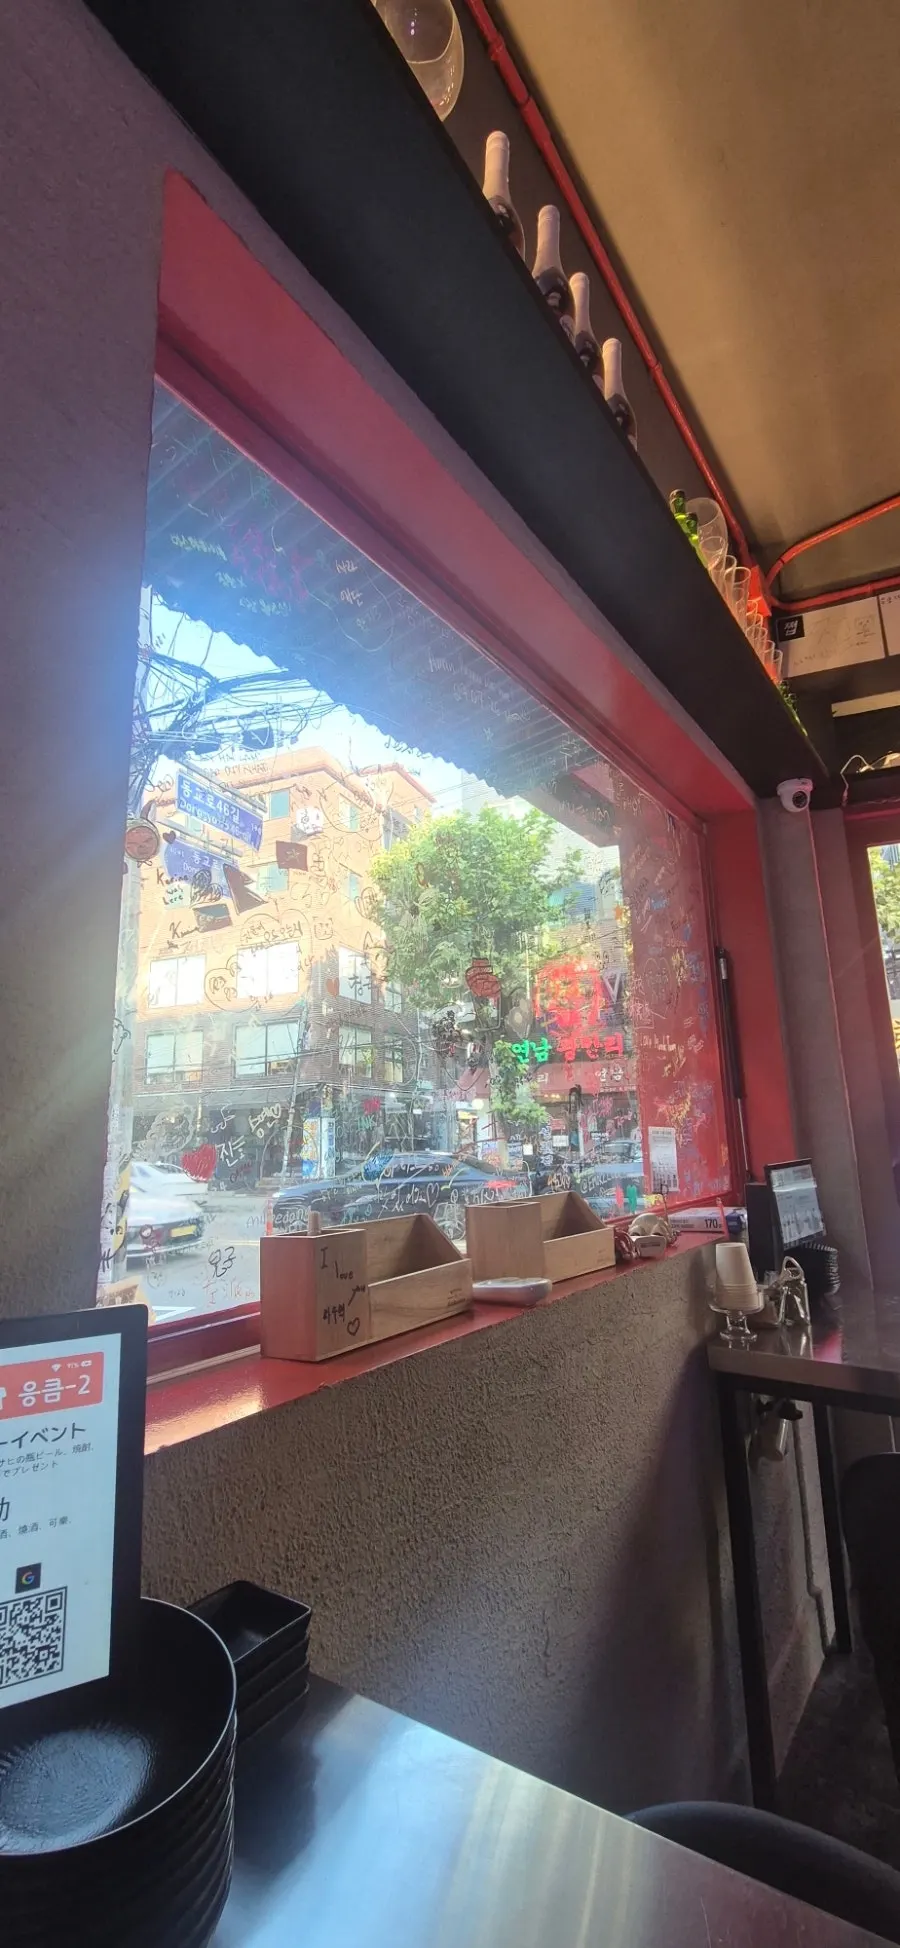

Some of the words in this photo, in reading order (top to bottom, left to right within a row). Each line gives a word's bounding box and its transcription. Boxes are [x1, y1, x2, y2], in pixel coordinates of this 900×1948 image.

[181, 779, 240, 825] 동교로46길
[511, 1036, 552, 1063] 연남
[320, 1246, 329, 1270] I
[334, 1260, 354, 1280] love
[17, 1374, 91, 1408] 응큼-2
